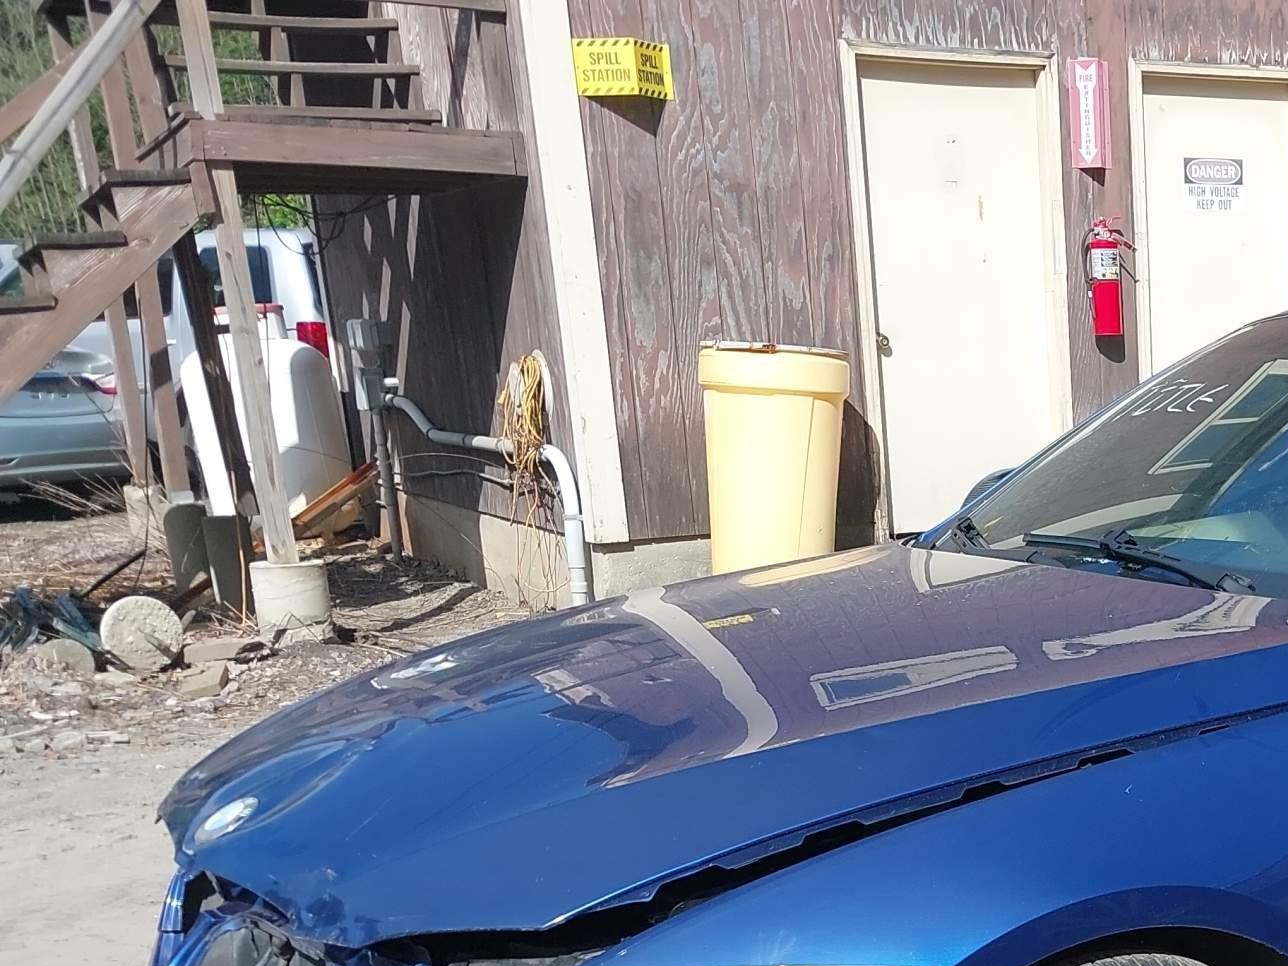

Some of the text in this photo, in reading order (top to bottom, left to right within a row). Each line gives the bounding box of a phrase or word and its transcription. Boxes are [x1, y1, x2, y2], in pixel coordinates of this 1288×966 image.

[589, 52, 621, 65] SPILL
[640, 53, 658, 69] SPILL
[582, 68, 631, 82] STATION
[638, 69, 665, 87] STATION
[1079, 74, 1093, 82] FIRE
[1191, 164, 1236, 179] DANGER
[1189, 186, 1239, 198] HIGH VOLTAGE
[1197, 199, 1232, 211] KEEP OUT
